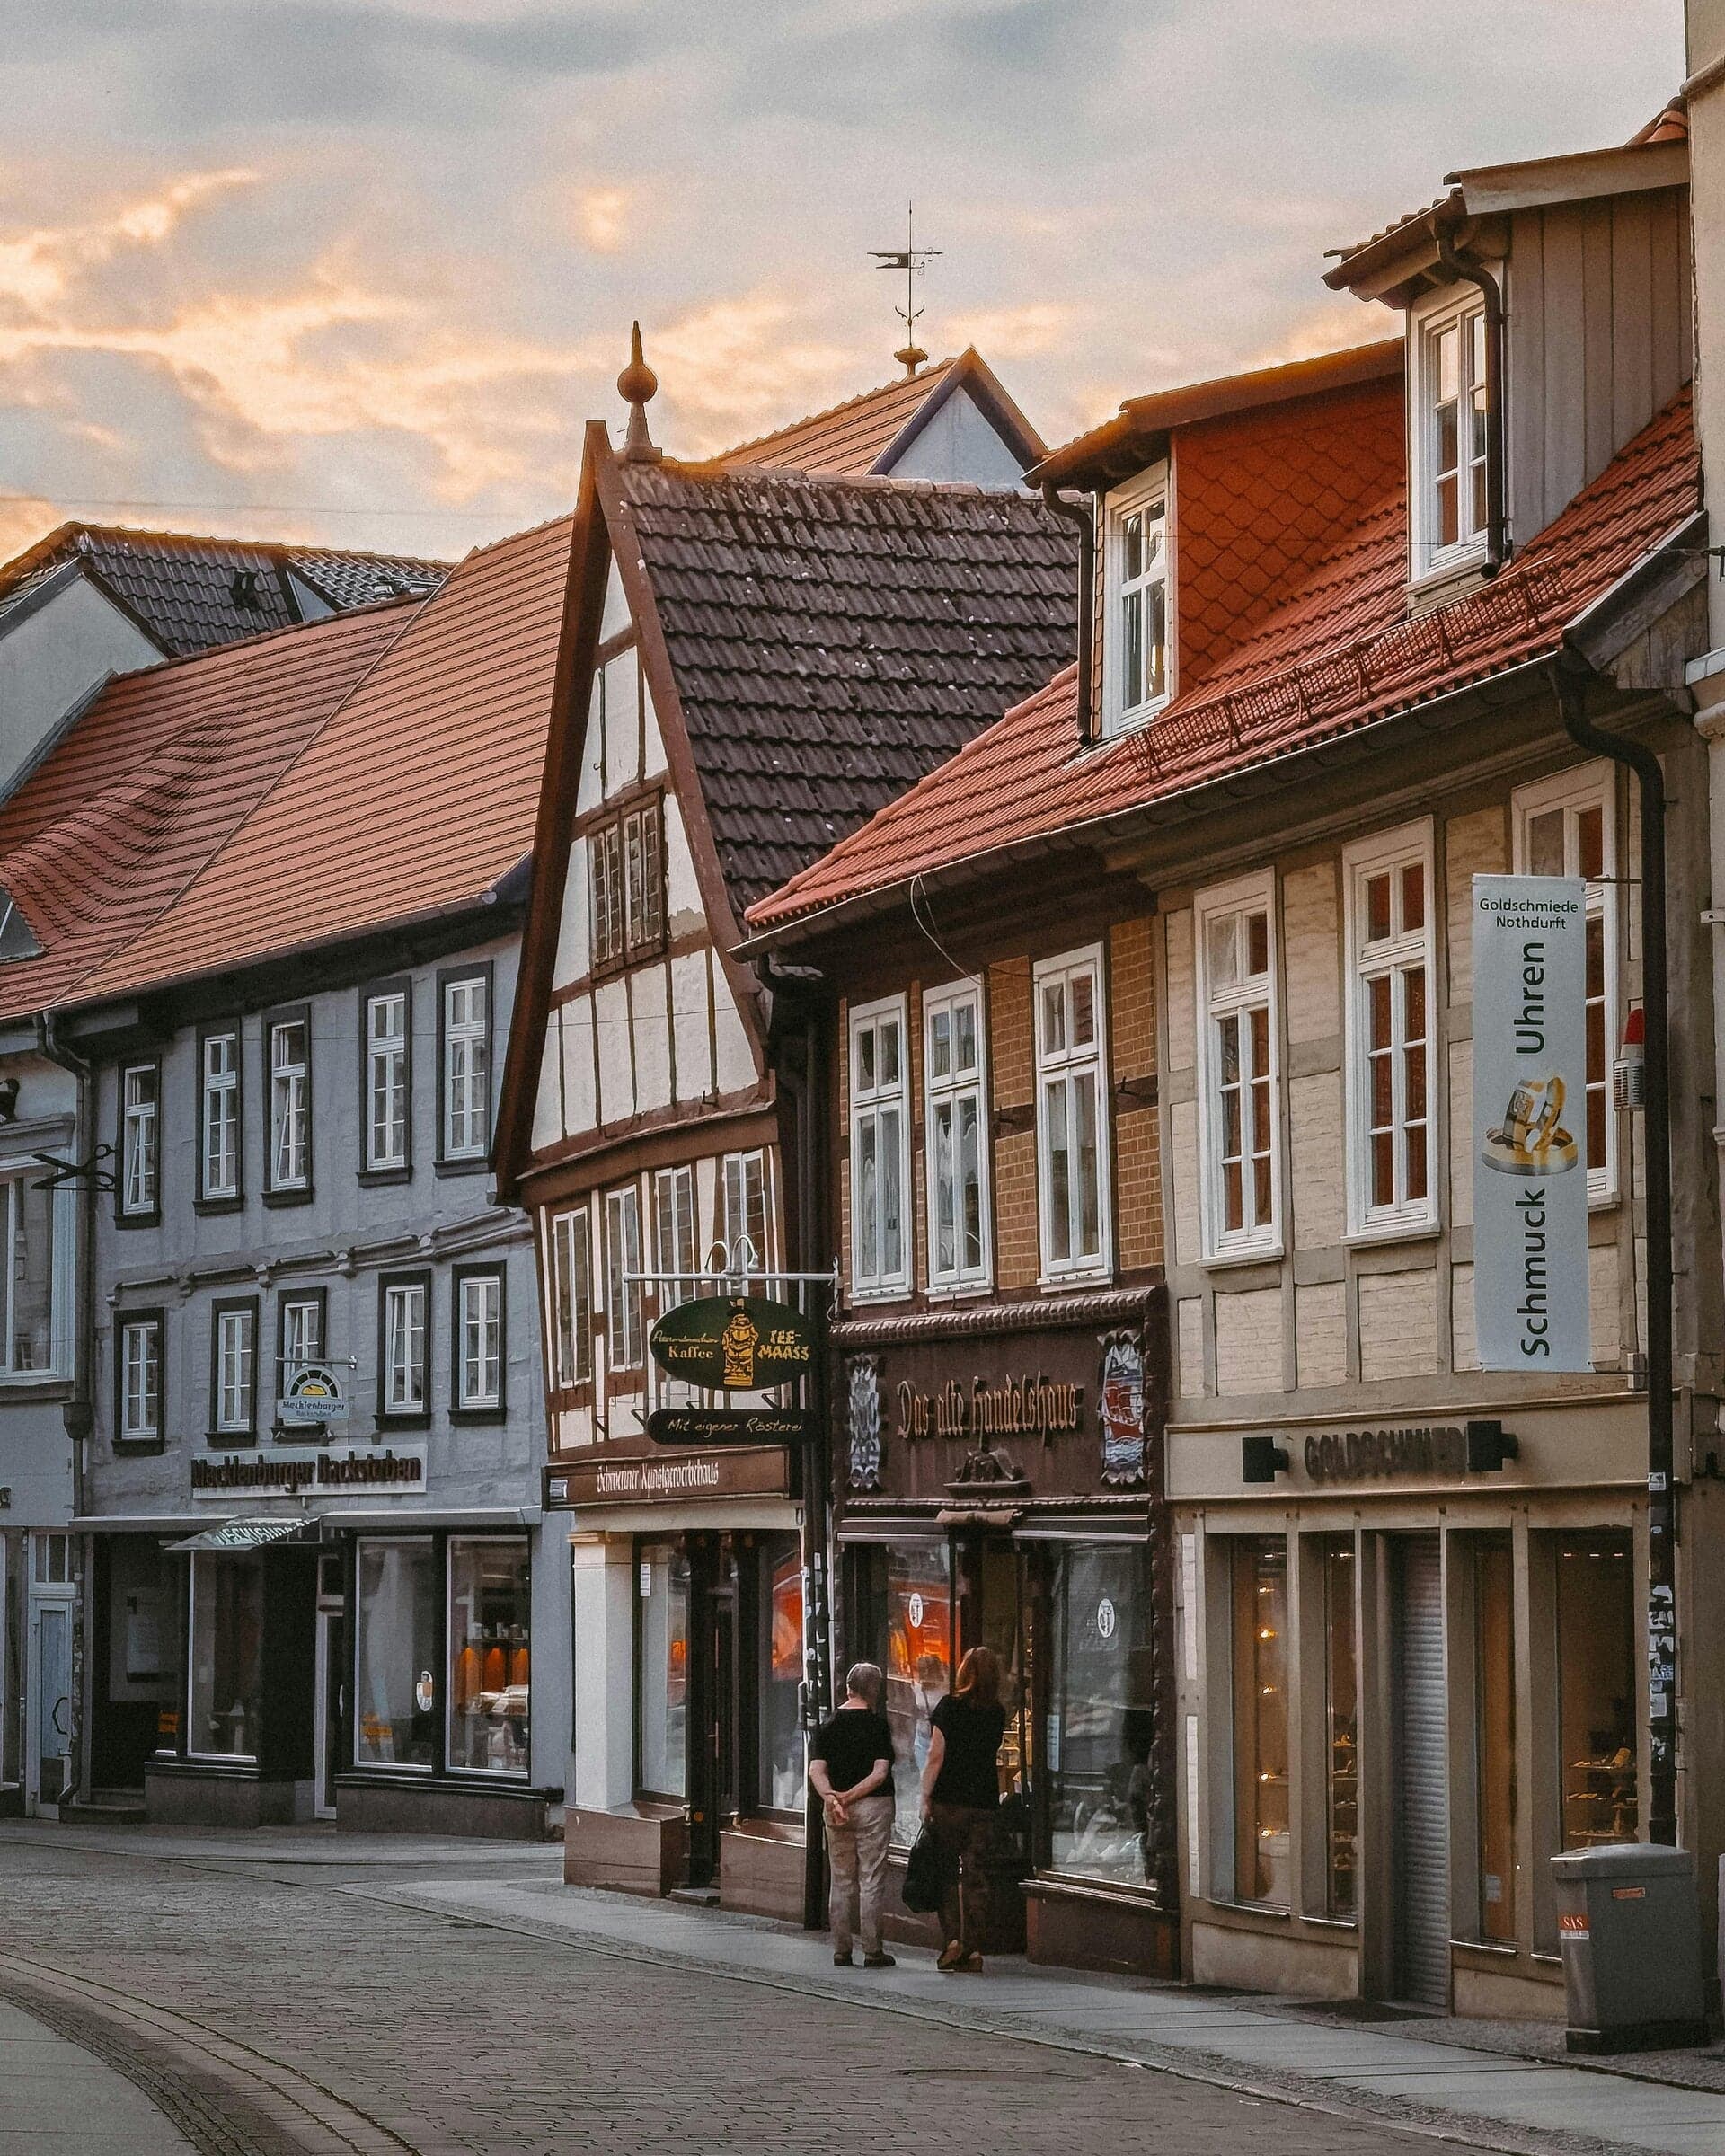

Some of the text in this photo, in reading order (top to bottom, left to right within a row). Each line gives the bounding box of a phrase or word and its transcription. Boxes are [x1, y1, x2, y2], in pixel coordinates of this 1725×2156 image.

[1479, 898, 1579, 913] Goldschmiede
[1496, 915, 1566, 929] Nothdurft
[1513, 942, 1545, 1054] Uhren
[1515, 1188, 1550, 1356] Schmuck
[770, 1329, 801, 1345] TEE-
[668, 1345, 714, 1359] Kaffee
[757, 1344, 809, 1361] MAASS
[898, 1380, 929, 1438] Das
[668, 1418, 689, 1432] Mit
[694, 1422, 739, 1438] eigener
[190, 1449, 421, 1493] Mecklenburger Backstuben
